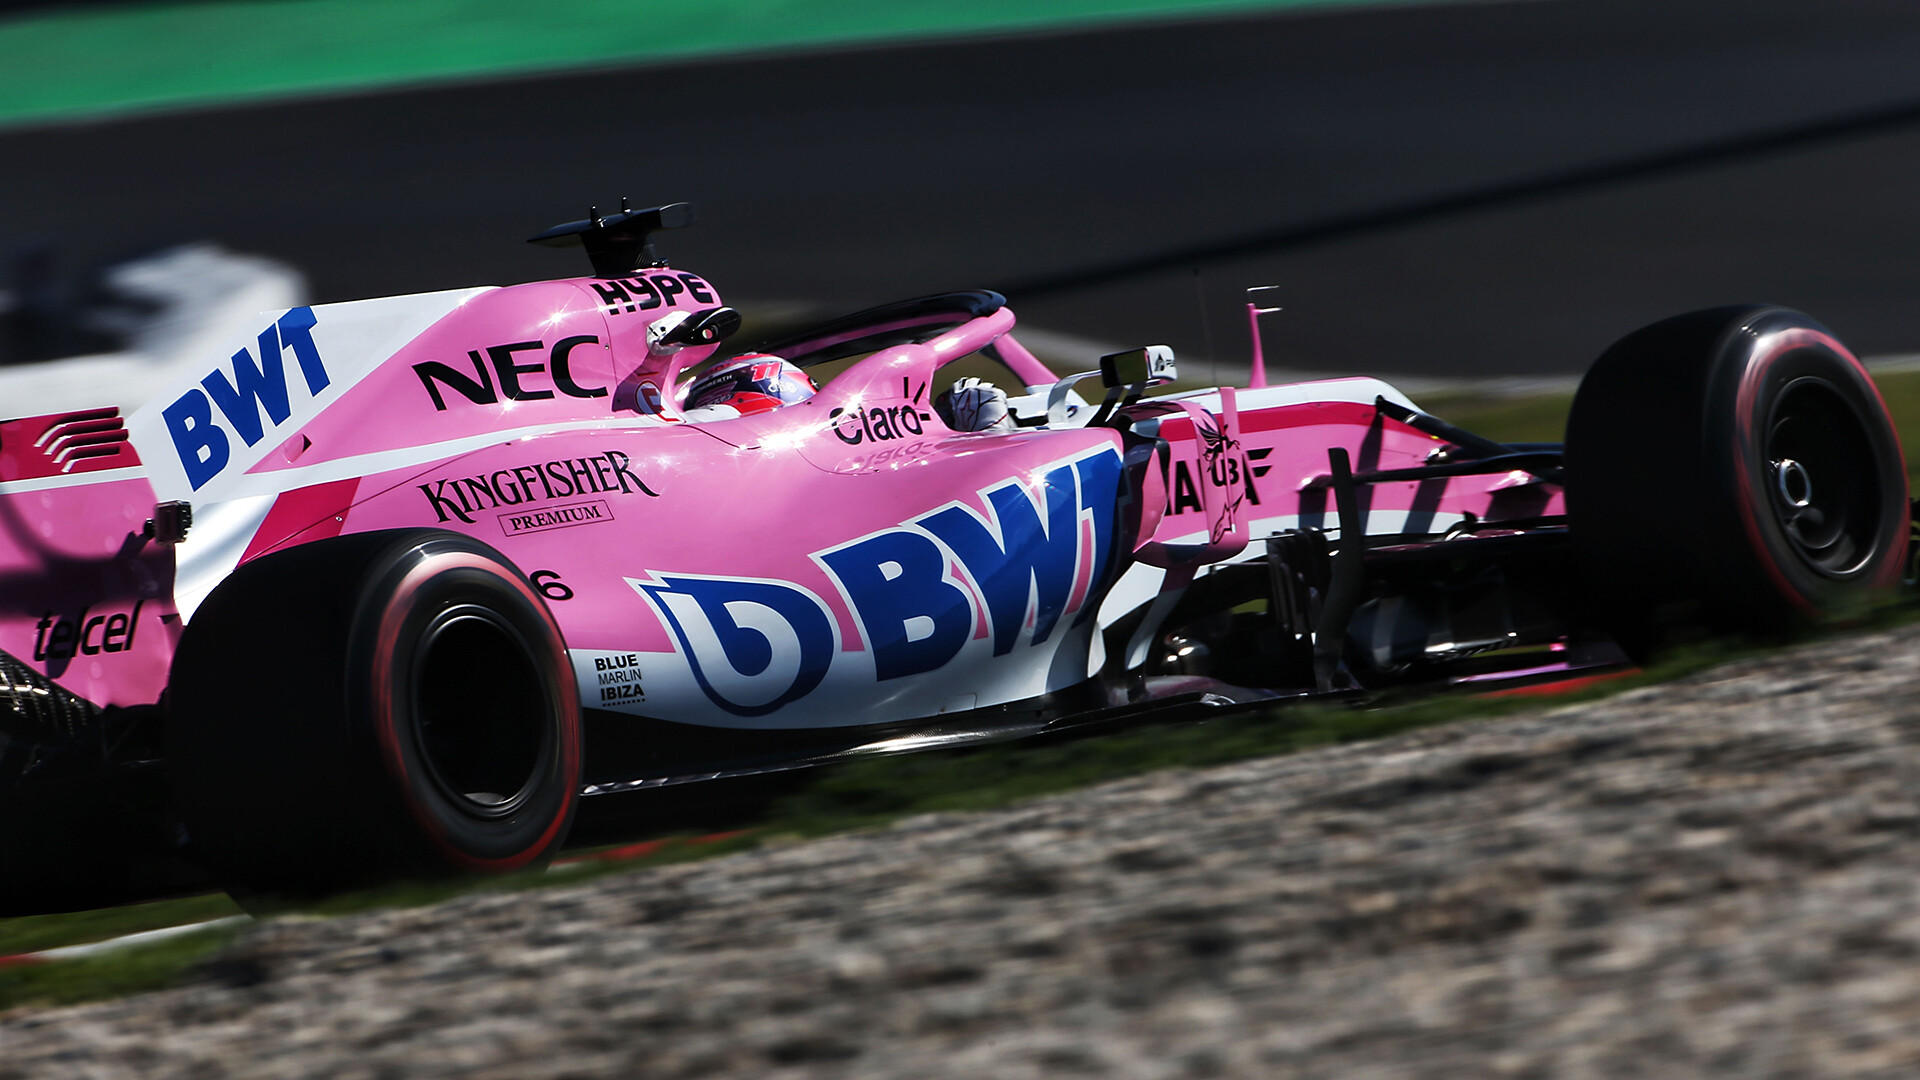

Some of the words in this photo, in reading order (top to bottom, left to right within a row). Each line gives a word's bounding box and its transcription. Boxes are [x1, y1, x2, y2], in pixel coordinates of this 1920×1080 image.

[589, 273, 714, 316] HYPE
[412, 335, 608, 411] NEC
[161, 306, 331, 491] BWT
[829, 400, 931, 445] Claro
[417, 450, 661, 524] KINGFISHER
[508, 505, 602, 531] PREMIUM
[818, 446, 1123, 682] BWT
[34, 600, 144, 662] telcel
[594, 654, 639, 671] BLUE
[598, 669, 642, 685] MARLIN
[600, 684, 645, 701] IBIZA
